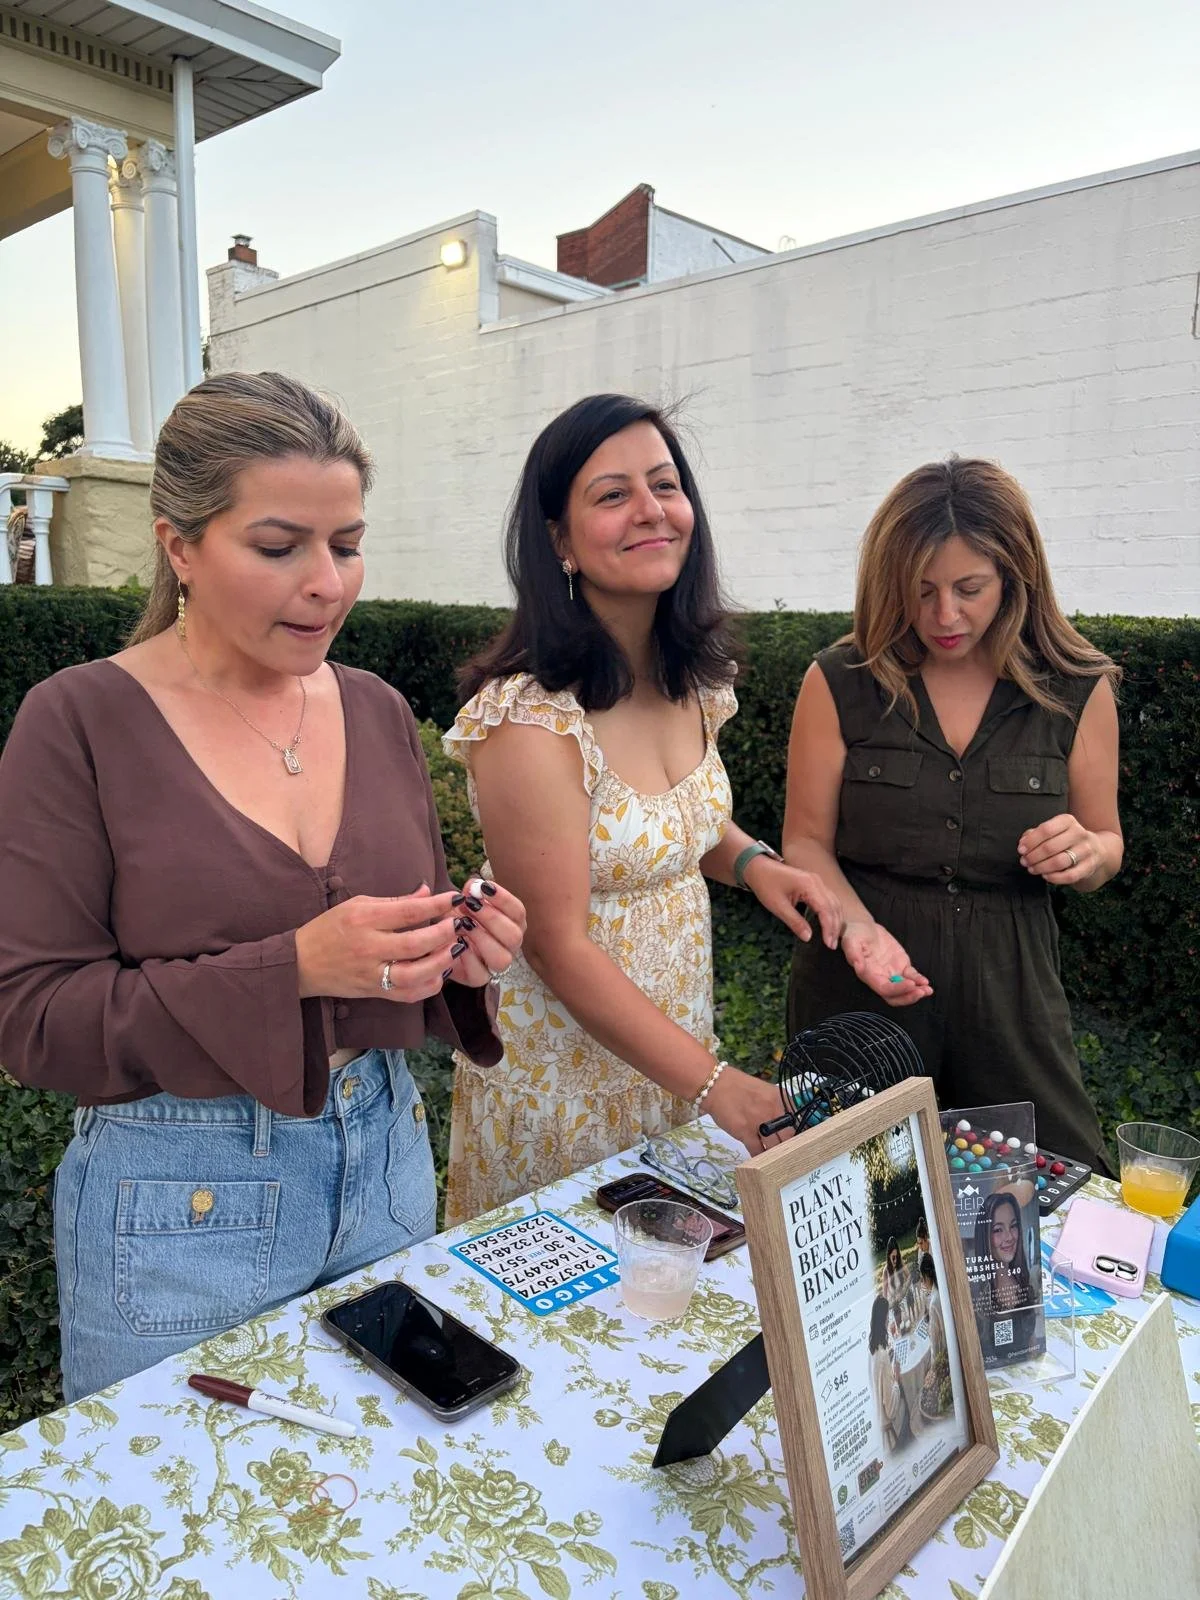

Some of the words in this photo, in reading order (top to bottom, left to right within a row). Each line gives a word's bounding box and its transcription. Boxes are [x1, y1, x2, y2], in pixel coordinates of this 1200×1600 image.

[890, 1135, 910, 1154] HEIR
[789, 1173, 843, 1225] PLANT
[845, 1176, 853, 1186] +
[953, 1197, 985, 1210] HEIR
[517, 1222, 535, 1232] 29
[535, 1216, 552, 1226] 12
[794, 1196, 853, 1249] CLEAN
[497, 1229, 517, 1241] 35
[532, 1231, 550, 1243] 27
[478, 1236, 498, 1248] 54
[511, 1239, 531, 1250] 32
[544, 1240, 565, 1252] 30
[798, 1216, 863, 1277] BEAUTY
[458, 1244, 478, 1255] 65
[493, 1246, 511, 1258] 48
[528, 1250, 547, 1259] FREE
[578, 1244, 597, 1254] 11
[473, 1254, 492, 1265] 63
[507, 1256, 528, 1268] 55
[560, 1251, 579, 1261] 16
[597, 1255, 608, 1263] 6
[965, 1254, 994, 1264] TURAL
[489, 1263, 509, 1274] 71
[541, 1257, 560, 1270] 43
[575, 1260, 595, 1272] 26
[966, 1261, 1005, 1273] MBSHELL
[524, 1266, 541, 1278] 49
[559, 1268, 578, 1281] 37
[802, 1248, 859, 1304] BINGO
[1007, 1266, 1021, 1277] $40
[502, 1273, 525, 1287] 75
[538, 1277, 558, 1289] 56
[518, 1285, 541, 1298] 74
[822, 1298, 831, 1307] THE
[831, 1290, 843, 1301] LAWN
[849, 1277, 859, 1287] HEIR
[820, 1315, 844, 1336] SEPTEMBER
[834, 1370, 849, 1392] $45
[832, 1428, 853, 1451] PROCEEDS
[853, 1422, 859, 1432] GO
[859, 1417, 865, 1425] TO
[833, 1444, 849, 1461] GREEN
[849, 1431, 860, 1446] KIDS
[860, 1420, 872, 1435] CLUB
[834, 1460, 841, 1471] OF
[840, 1434, 868, 1465] RIDGEWOOD
